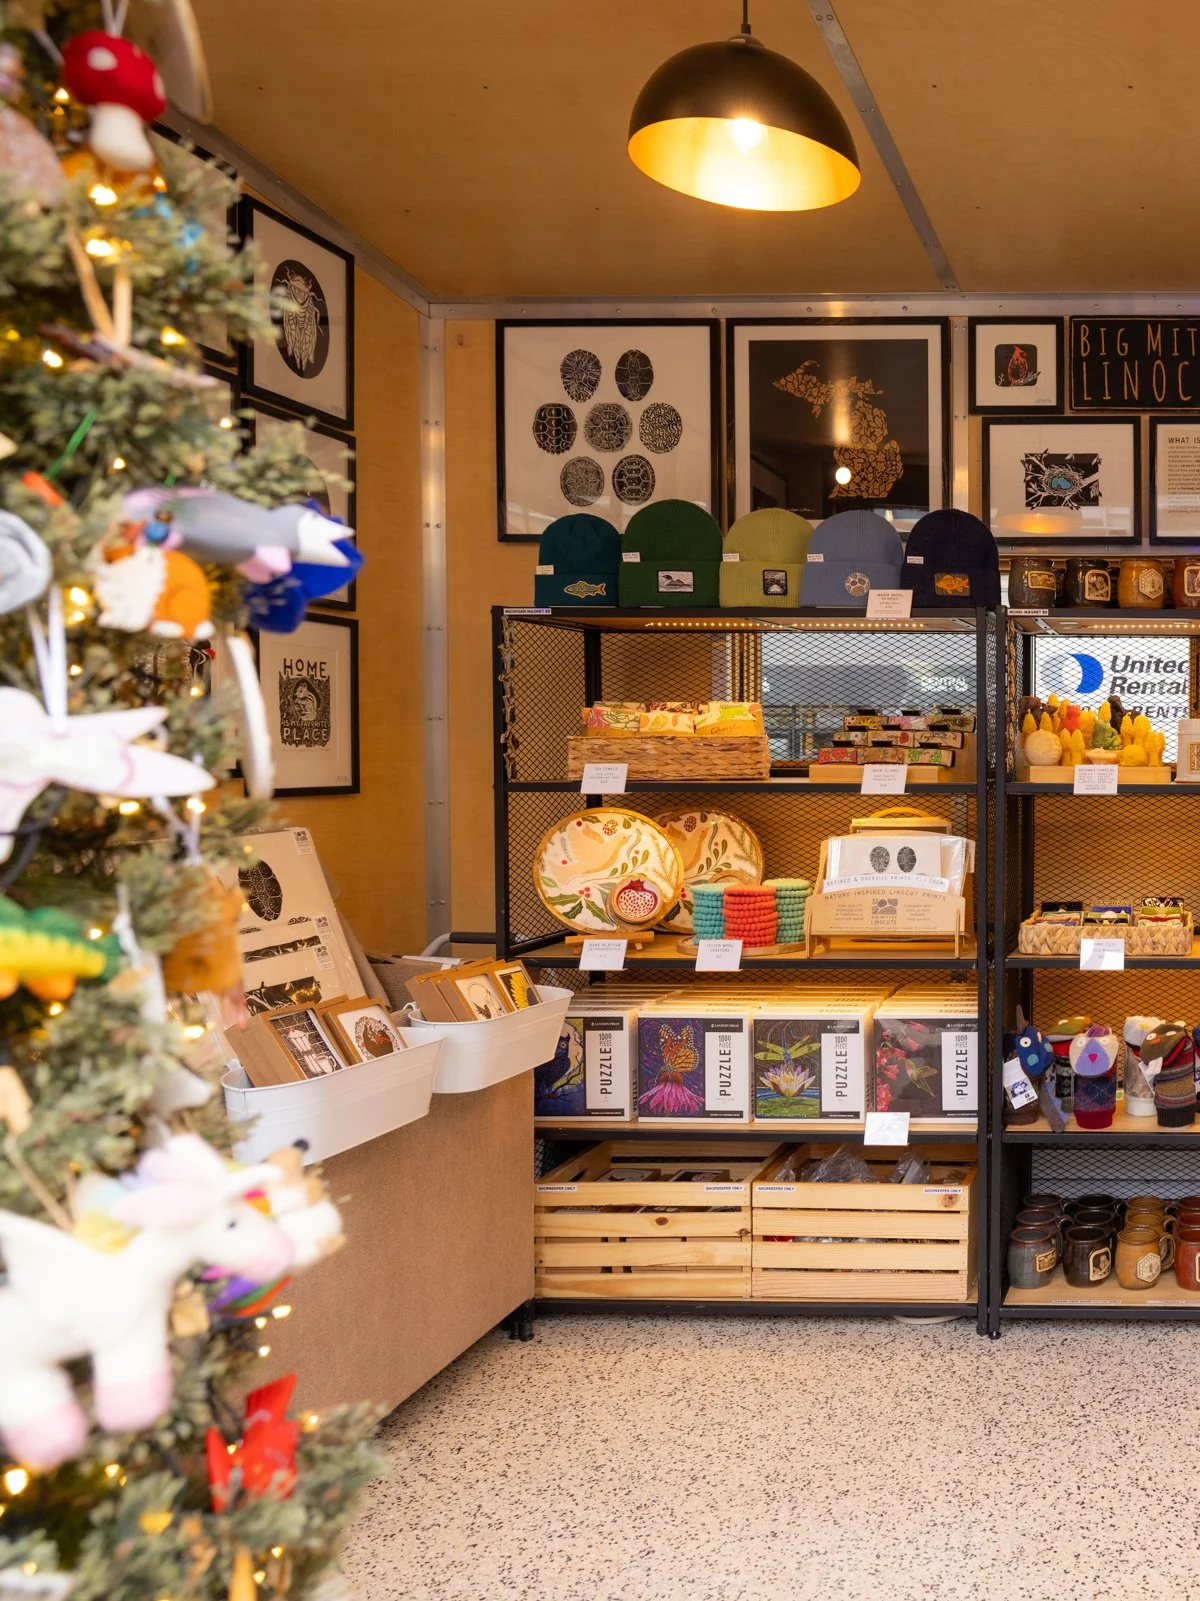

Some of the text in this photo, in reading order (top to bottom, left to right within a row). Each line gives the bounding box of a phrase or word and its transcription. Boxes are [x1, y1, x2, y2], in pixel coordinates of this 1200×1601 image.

[1080, 325, 1129, 357] BIG
[283, 658, 327, 678] HOME
[283, 728, 328, 741] PLACE
[824, 890, 885, 900] NATURE-INSPIRED
[922, 892, 946, 901] PRINTS
[600, 1048, 612, 1094] PUZZLE
[719, 1050, 731, 1096] PUZZLE
[836, 1051, 847, 1097] PUZZLE
[956, 1050, 968, 1096] PUZZLE
